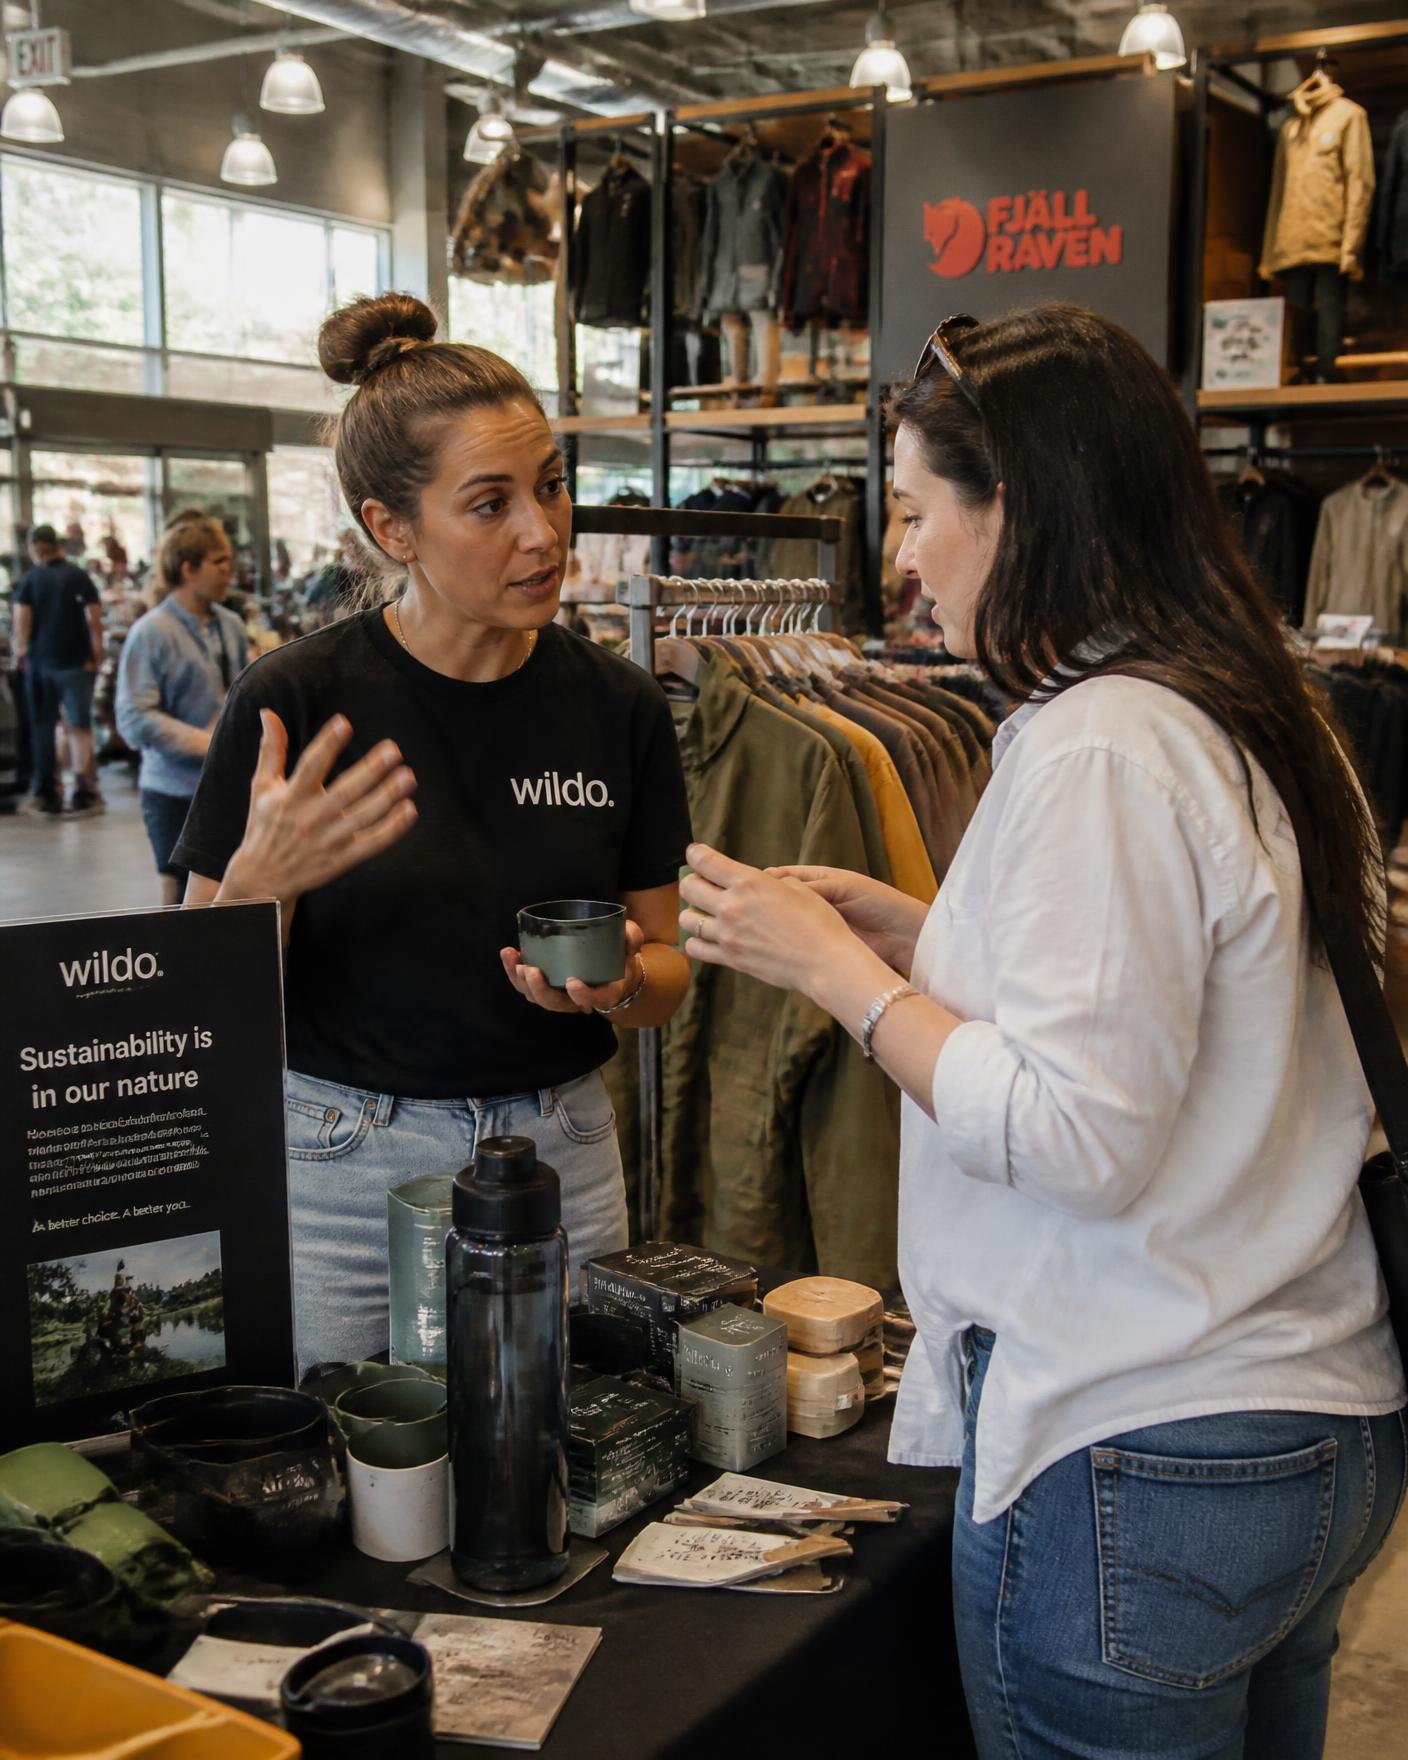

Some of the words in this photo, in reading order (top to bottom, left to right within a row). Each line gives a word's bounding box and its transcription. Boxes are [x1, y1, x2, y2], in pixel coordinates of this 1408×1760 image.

[17, 35, 56, 76] EXIT
[987, 190, 1097, 234] FJÄLL
[986, 225, 1122, 272] RAVEN
[510, 771, 615, 807] wildo.
[59, 947, 164, 987] wildo.
[20, 1029, 188, 1072] Sustainability
[193, 1026, 213, 1049] is
[32, 1084, 57, 1109] in
[65, 1081, 110, 1104] our
[117, 1069, 199, 1097] nature
